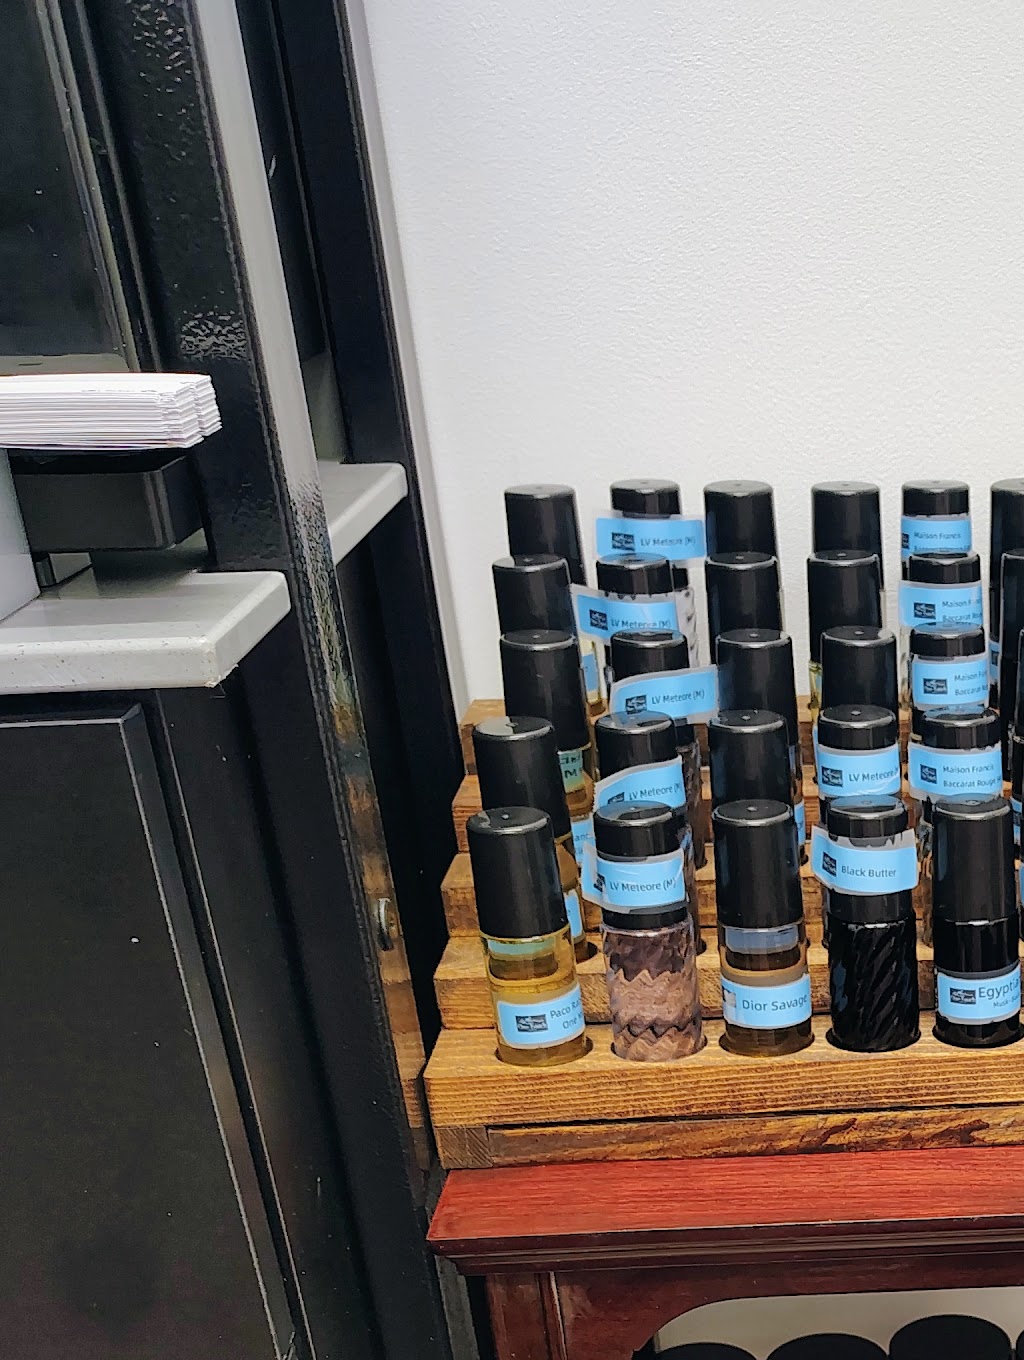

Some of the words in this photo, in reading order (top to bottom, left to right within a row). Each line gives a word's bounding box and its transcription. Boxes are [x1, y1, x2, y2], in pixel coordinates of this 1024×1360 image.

[651, 695, 663, 705] LV
[663, 692, 693, 704] Meteore
[942, 765, 970, 774] Maison
[848, 773, 860, 782] LV
[943, 779, 976, 788] Baccarat
[628, 789, 639, 801] LV
[640, 785, 673, 798] Meteore
[841, 865, 867, 877] Black
[868, 868, 897, 878] Butter
[609, 880, 620, 891] LV
[621, 881, 661, 893] Meteore
[663, 877, 676, 891] (M)
[741, 999, 768, 1011] Dior
[550, 1007, 571, 1019] Paco
[562, 1017, 577, 1030] One
